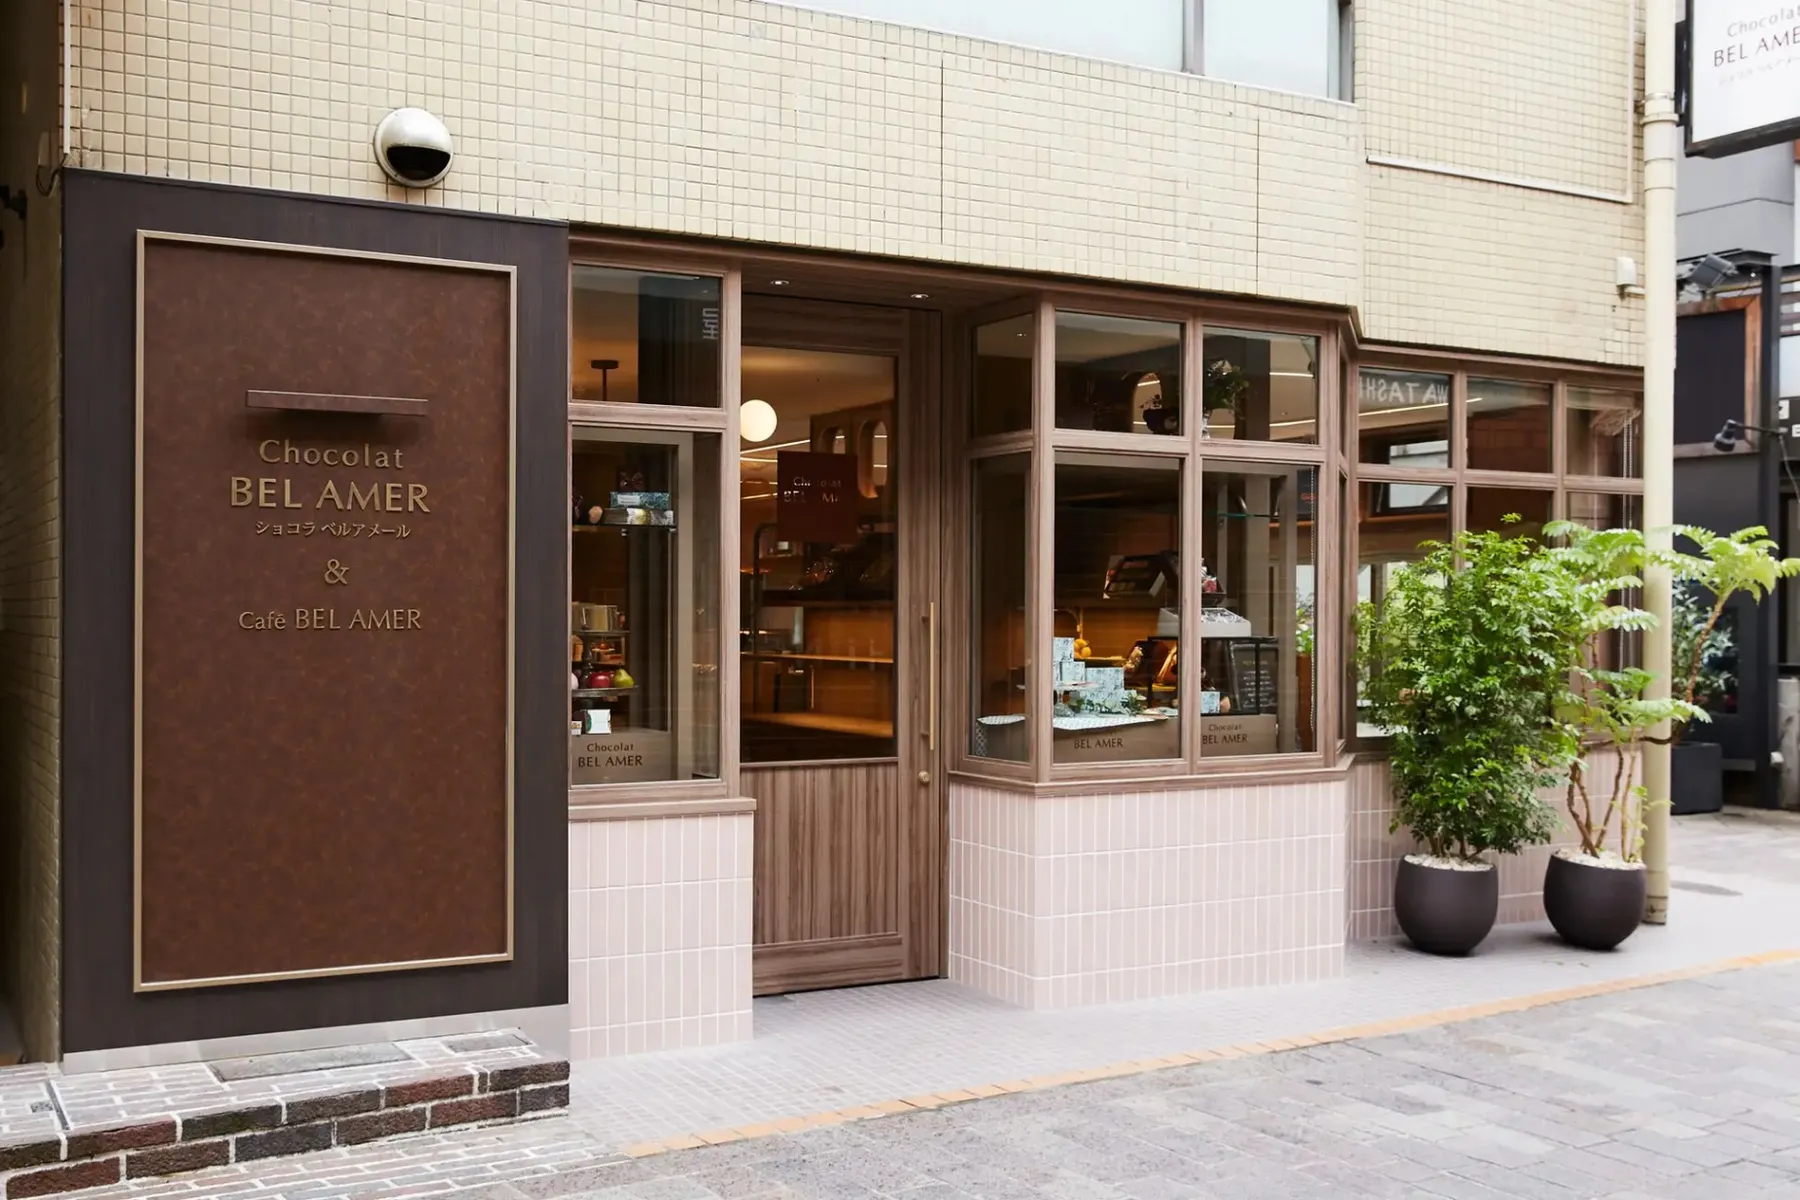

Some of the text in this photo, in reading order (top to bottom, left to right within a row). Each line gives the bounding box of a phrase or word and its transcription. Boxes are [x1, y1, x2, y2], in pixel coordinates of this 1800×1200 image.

[1713, 43, 1748, 67] BEL
[259, 439, 404, 469] Chocolat
[231, 476, 431, 513] BEL AMER
[324, 558, 350, 585] &
[239, 608, 422, 630] Café BEL AMER
[586, 742, 634, 752] Chocolat
[1073, 737, 1124, 749] BEL AMER
[1202, 733, 1248, 745] BEL AMER
[578, 755, 643, 768] BEL AMER
